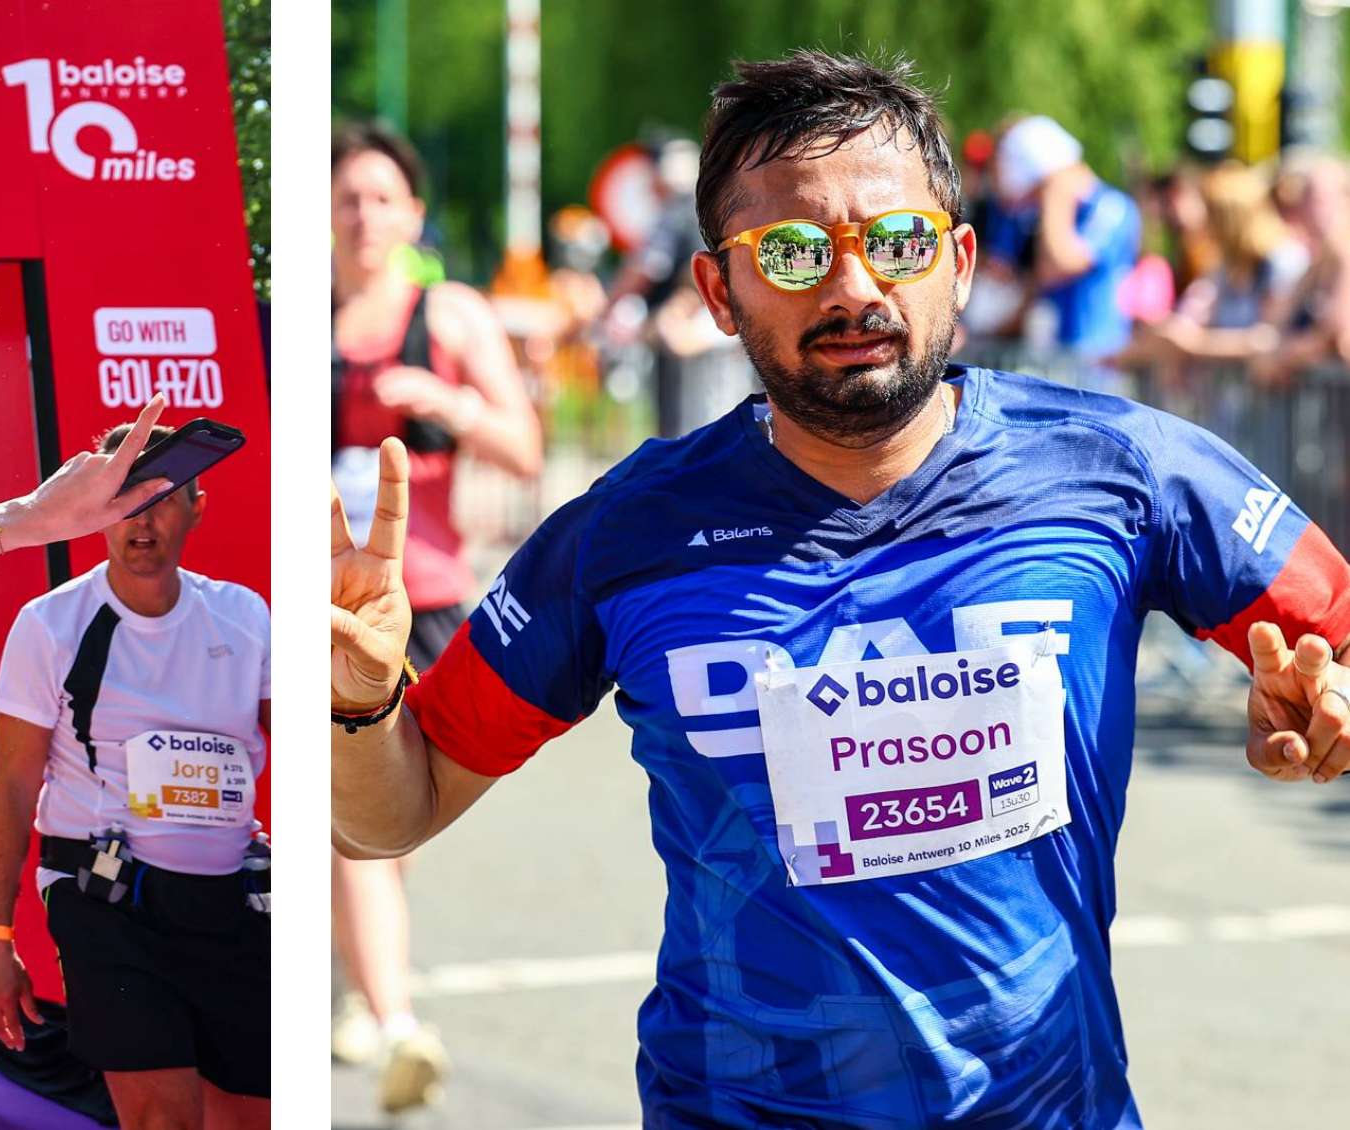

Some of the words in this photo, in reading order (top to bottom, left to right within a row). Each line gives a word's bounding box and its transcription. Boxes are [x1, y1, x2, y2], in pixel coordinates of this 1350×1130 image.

[57, 56, 186, 86] baloise
[60, 87, 188, 98] ANTWERP
[1, 58, 138, 180] 10
[101, 149, 196, 181] miles
[107, 319, 134, 342] GO
[137, 320, 187, 342] WITH
[97, 358, 224, 408] GOLAZO
[855, 658, 1021, 707] baloise
[170, 734, 236, 756] baloise
[830, 722, 1011, 772] Prasoon
[172, 759, 220, 785] Jorg
[992, 775, 1023, 790] Wave
[1023, 766, 1036, 785] 2
[171, 788, 210, 805] 7382
[859, 791, 969, 831] 23654
[862, 855, 904, 868] Baloise
[907, 846, 955, 863] Antwerp
[959, 841, 972, 853] 10
[975, 835, 1001, 849] Miles
[1005, 823, 1030, 839] 2025
